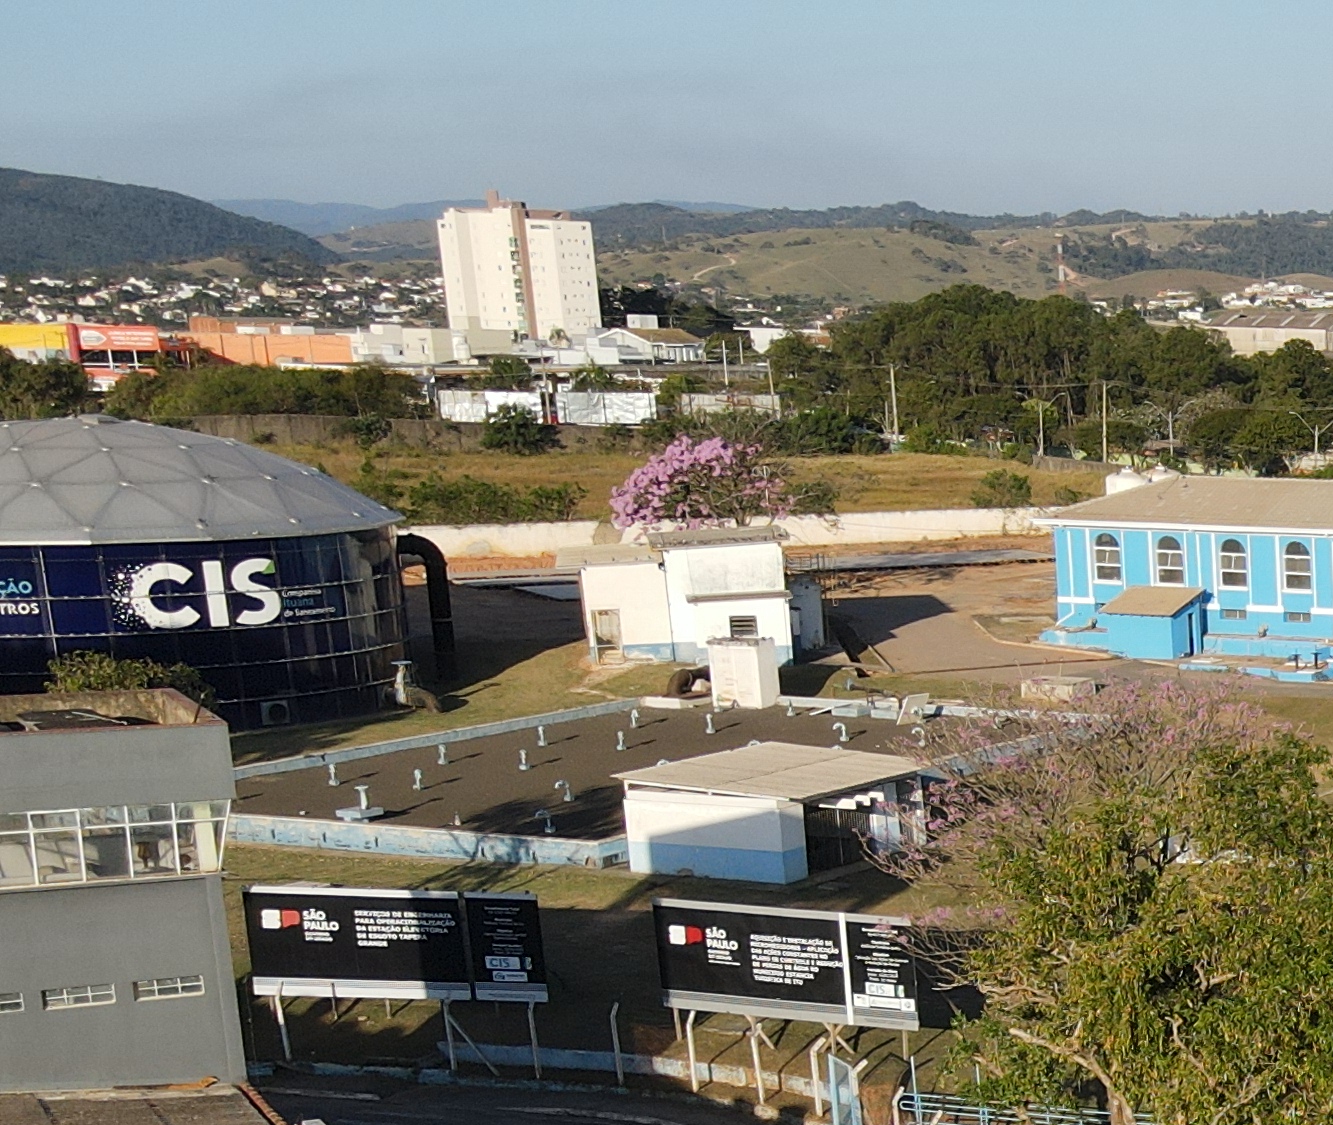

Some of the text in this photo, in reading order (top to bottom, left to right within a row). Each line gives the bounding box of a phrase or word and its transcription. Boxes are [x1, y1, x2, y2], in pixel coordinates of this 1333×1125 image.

[130, 558, 282, 629] CIS
[302, 908, 326, 920] SÃO
[303, 921, 340, 931] PAULO
[705, 926, 727, 939] SÃO
[706, 938, 738, 950] PAULO
